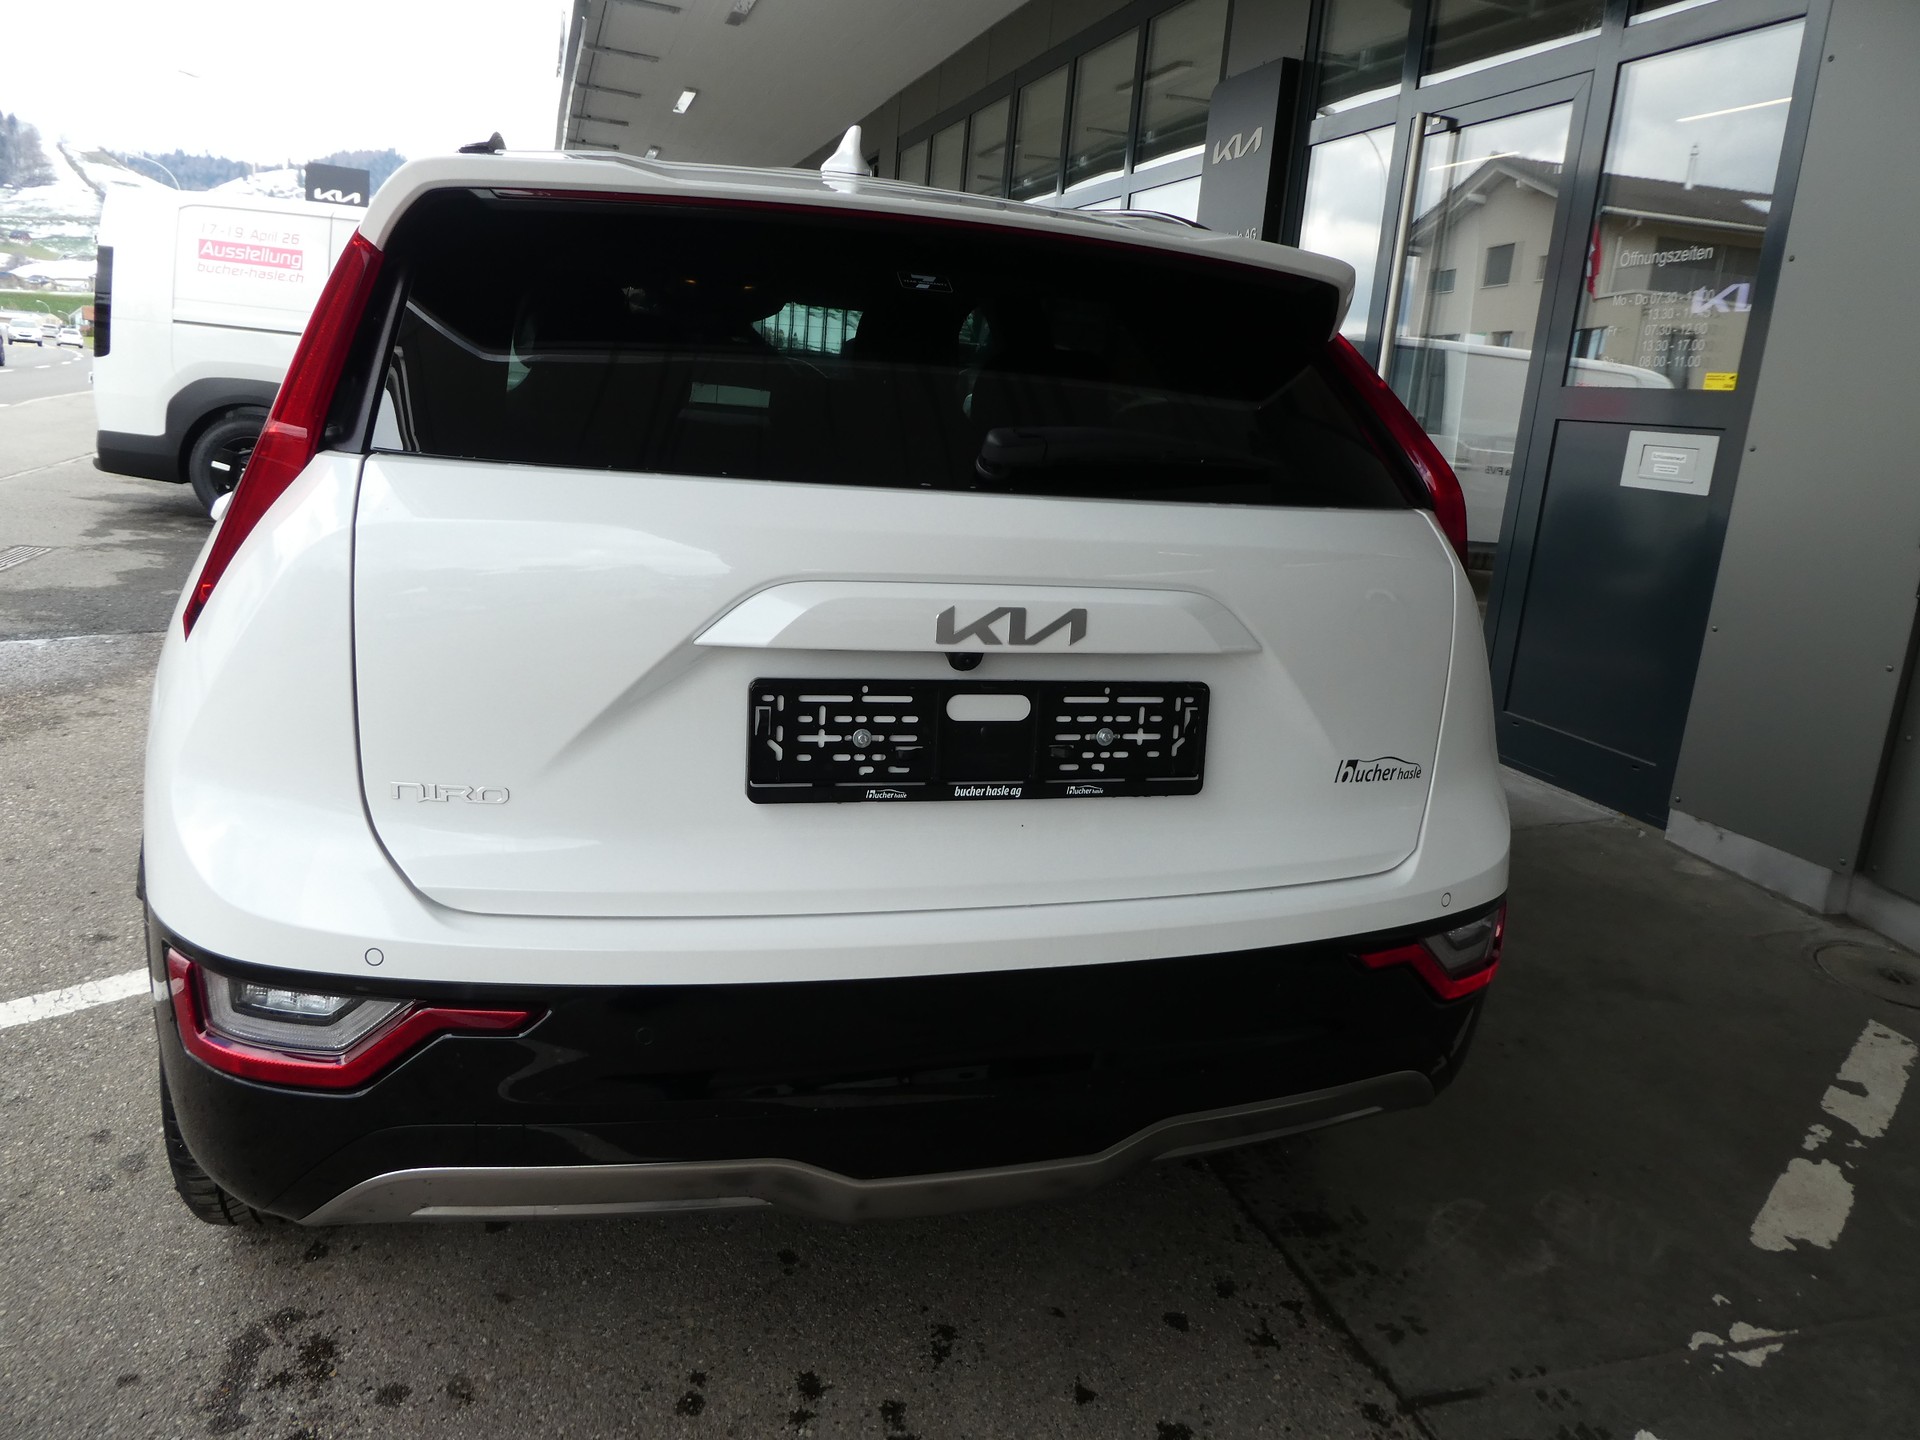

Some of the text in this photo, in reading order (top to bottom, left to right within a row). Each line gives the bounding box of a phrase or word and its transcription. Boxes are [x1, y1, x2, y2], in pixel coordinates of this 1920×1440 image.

[1212, 126, 1263, 165] KIA
[314, 187, 361, 204] KIA
[250, 229, 278, 243] April
[282, 232, 300, 245] 26
[200, 240, 302, 269] Ausstellung
[1619, 245, 1714, 268] Öffnungszeiten
[197, 262, 304, 284] bucher-hasle.ch
[1612, 295, 1627, 306] Mo
[1634, 294, 1649, 305] Do
[1649, 292, 1678, 305] 07.30
[1648, 308, 1674, 320] 13.30
[1607, 325, 1618, 337] Fr
[1644, 324, 1673, 336] 07.30
[1680, 322, 1708, 335] 12.00
[1642, 340, 1669, 352] 13.30
[1677, 339, 1705, 351] 17.00
[1639, 355, 1666, 367] 08.00
[1674, 355, 1701, 367] 11.00
[935, 605, 1088, 646] KIA
[1397, 766, 1422, 780] hasle
[390, 780, 510, 805] NIRO
[954, 785, 1022, 798] bucher hasle ag
